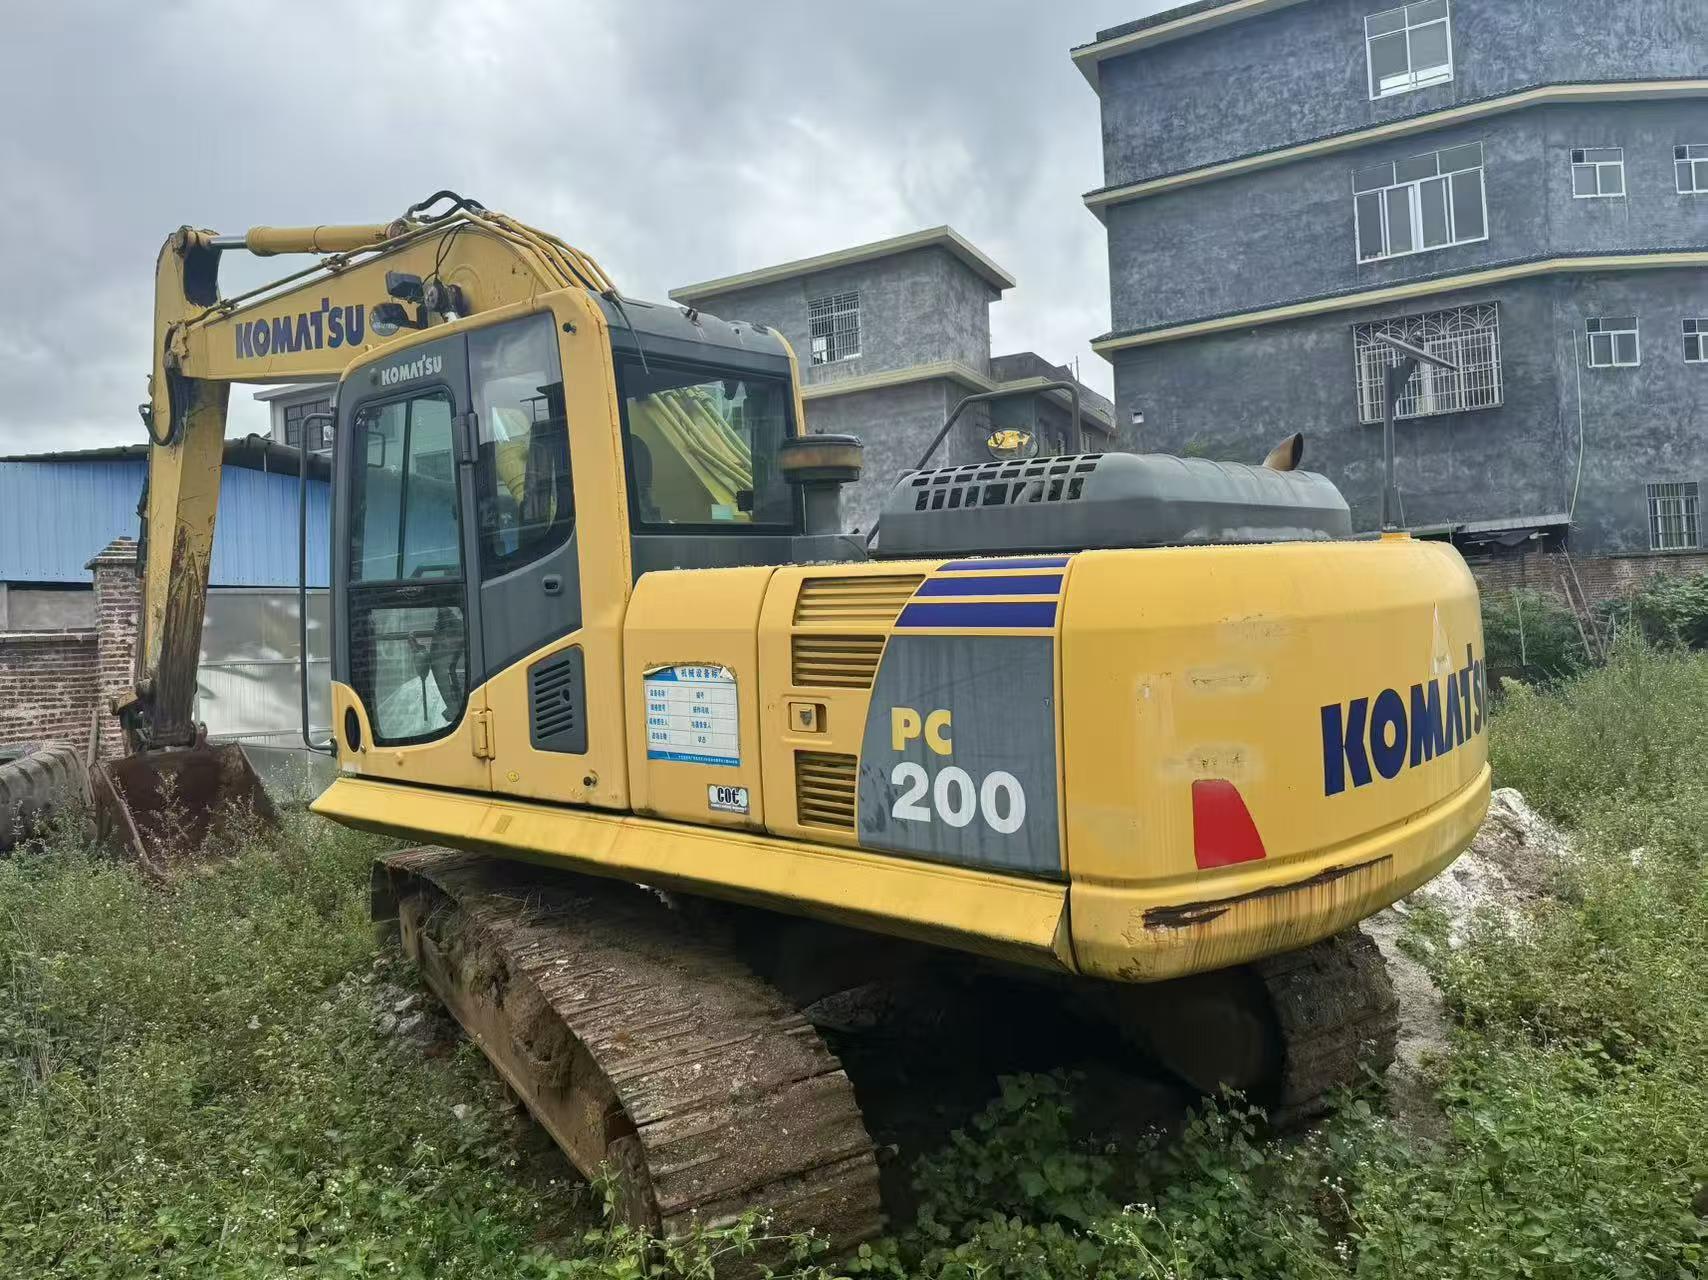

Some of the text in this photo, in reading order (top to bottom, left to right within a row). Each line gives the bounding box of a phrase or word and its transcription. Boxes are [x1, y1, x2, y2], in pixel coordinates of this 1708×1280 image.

[235, 297, 365, 360] KOMATSU
[381, 354, 442, 386] KOMATSU
[681, 668, 722, 679] 机械设备标
[890, 706, 953, 756] PC
[1320, 642, 1487, 797] KOMATSU
[890, 761, 1027, 834] 200
